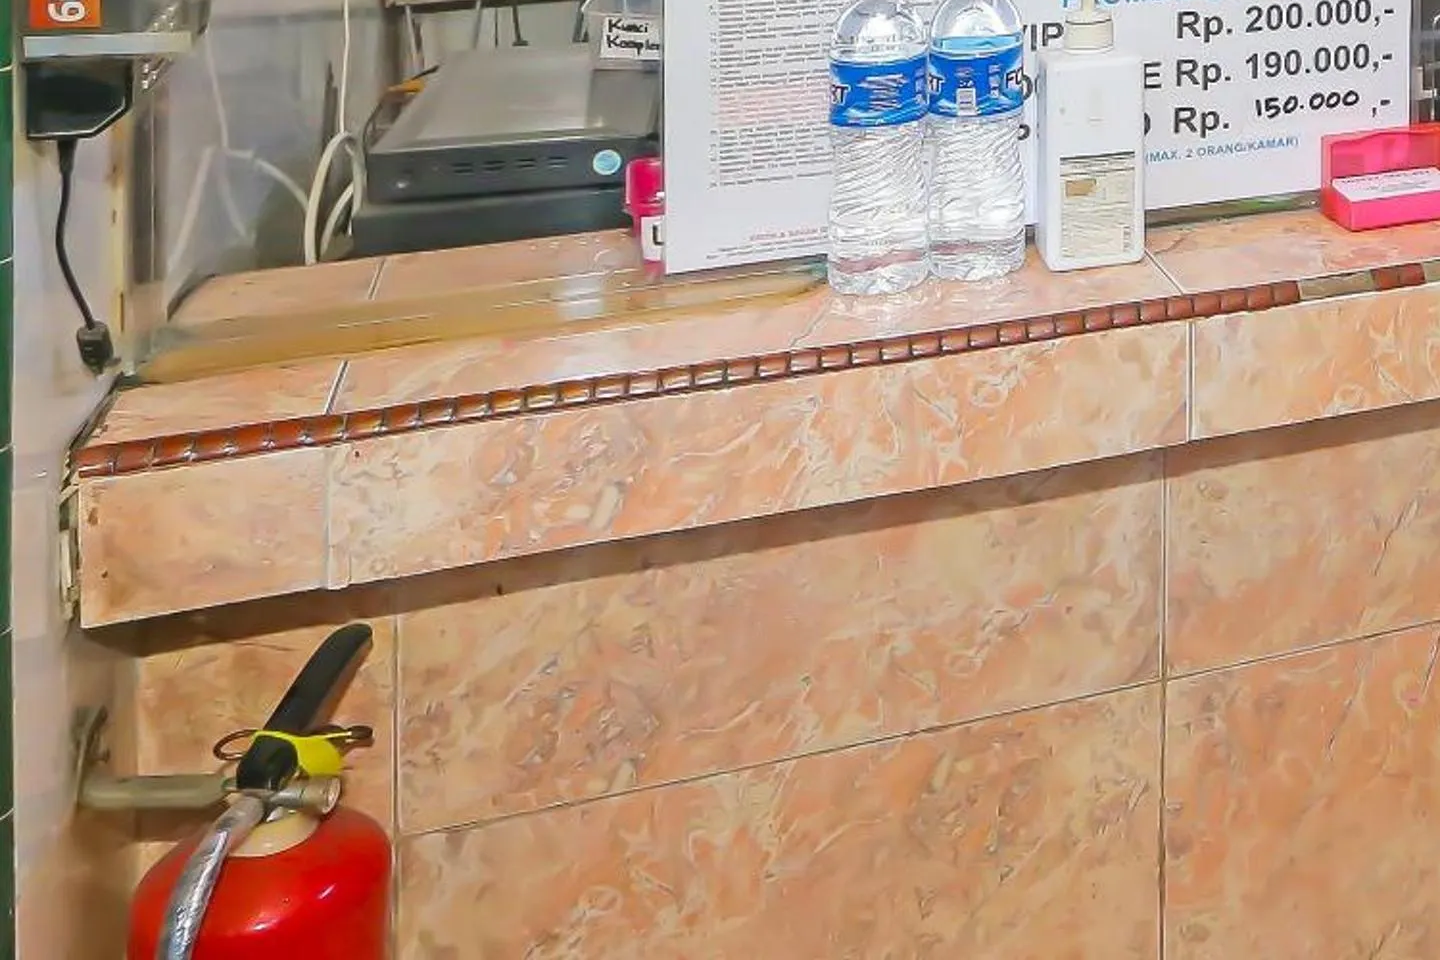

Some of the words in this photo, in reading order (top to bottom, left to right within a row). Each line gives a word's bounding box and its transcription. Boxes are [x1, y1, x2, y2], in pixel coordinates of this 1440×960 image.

[1176, 10, 1233, 43] Rp.
[1175, 58, 1231, 91] Rp.
[1245, 43, 1393, 79] 190.000,-
[1173, 106, 1230, 138] Rp.
[1145, 151, 1181, 164] (MAX.
[1186, 148, 1195, 158] 2
